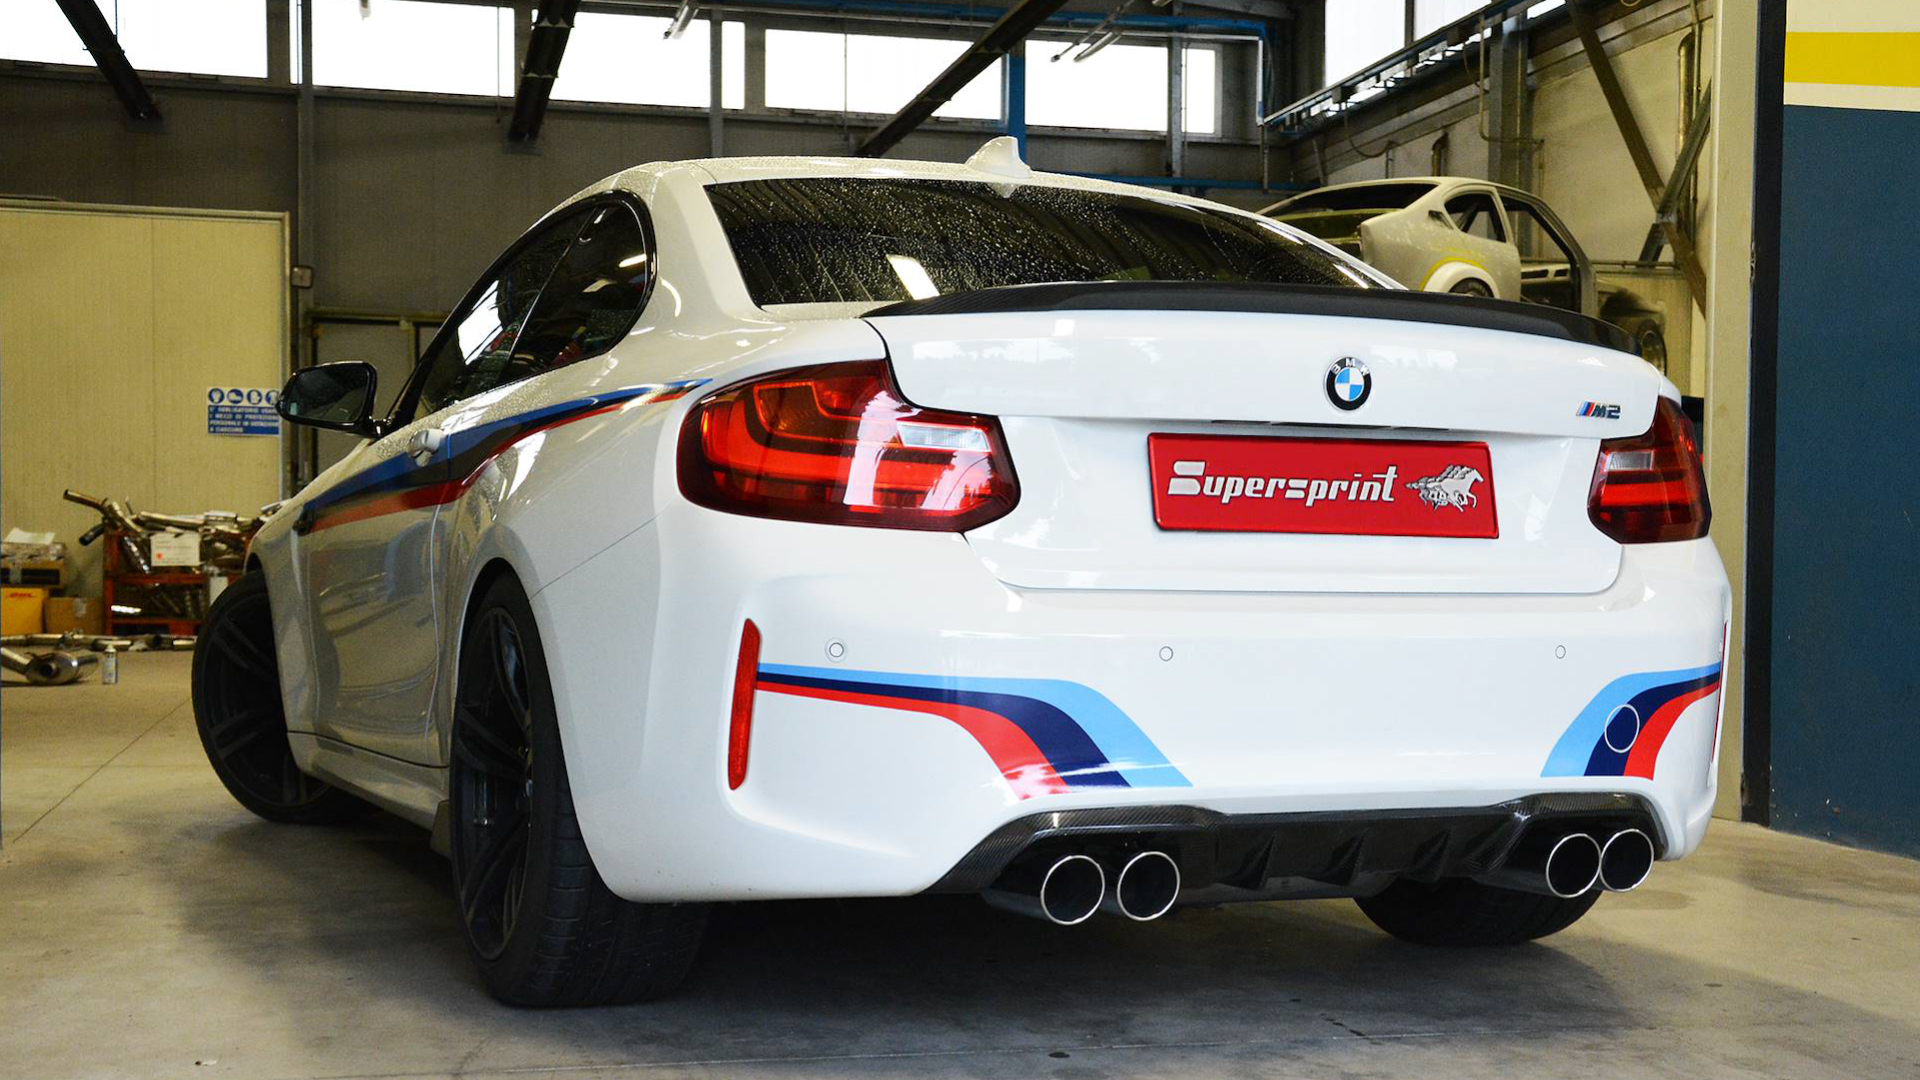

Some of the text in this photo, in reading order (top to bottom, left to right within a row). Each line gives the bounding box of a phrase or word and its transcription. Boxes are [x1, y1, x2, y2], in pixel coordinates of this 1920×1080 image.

[1330, 358, 1370, 376] BMW
[1590, 403, 1621, 419] M2
[1167, 460, 1397, 506] Supersprint
